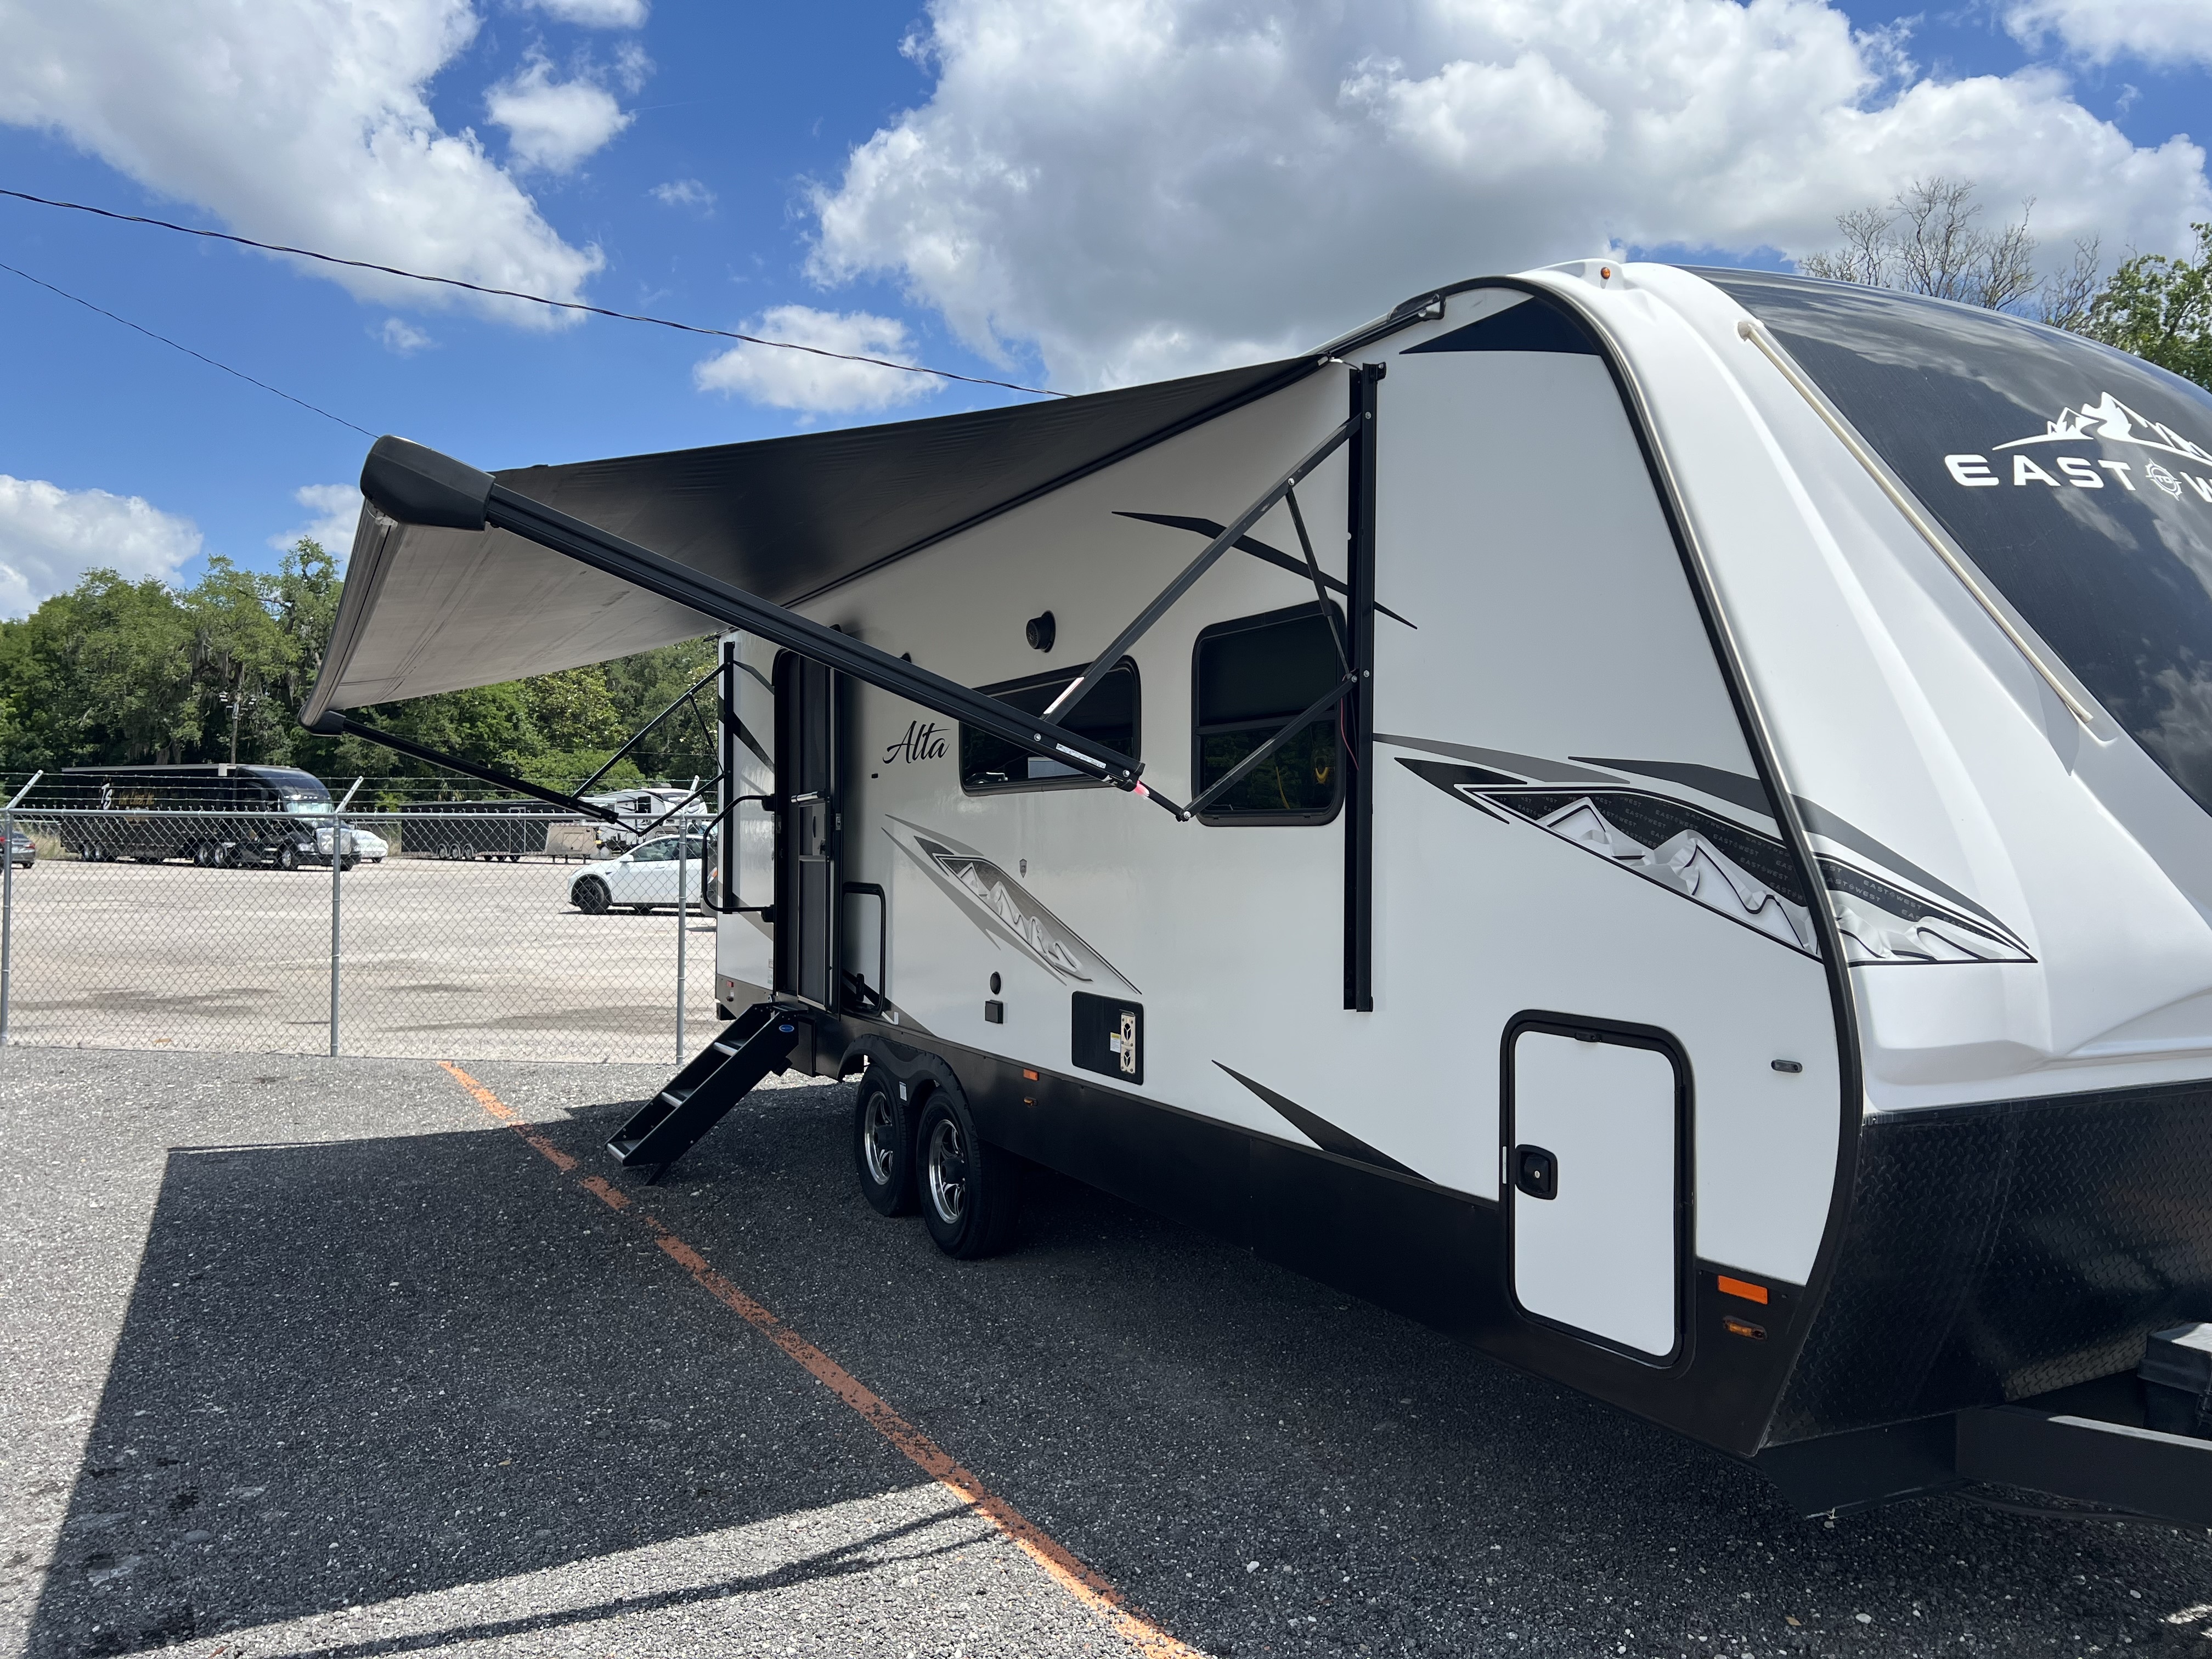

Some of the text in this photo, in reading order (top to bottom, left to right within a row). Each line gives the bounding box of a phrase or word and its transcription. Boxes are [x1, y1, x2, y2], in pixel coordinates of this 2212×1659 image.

[1944, 454, 2136, 491] EAST
[882, 720, 951, 764] Alta
[1625, 808, 1644, 819] EAST
[1655, 809, 1674, 821] EAST
[1713, 833, 1733, 846] EAST
[1739, 844, 1759, 856] WEST
[1740, 857, 1788, 881] EAST WEST
[1769, 882, 1791, 894] EAST
[1855, 887, 1881, 902] WEST
[1863, 879, 1922, 910] EAST WEST
